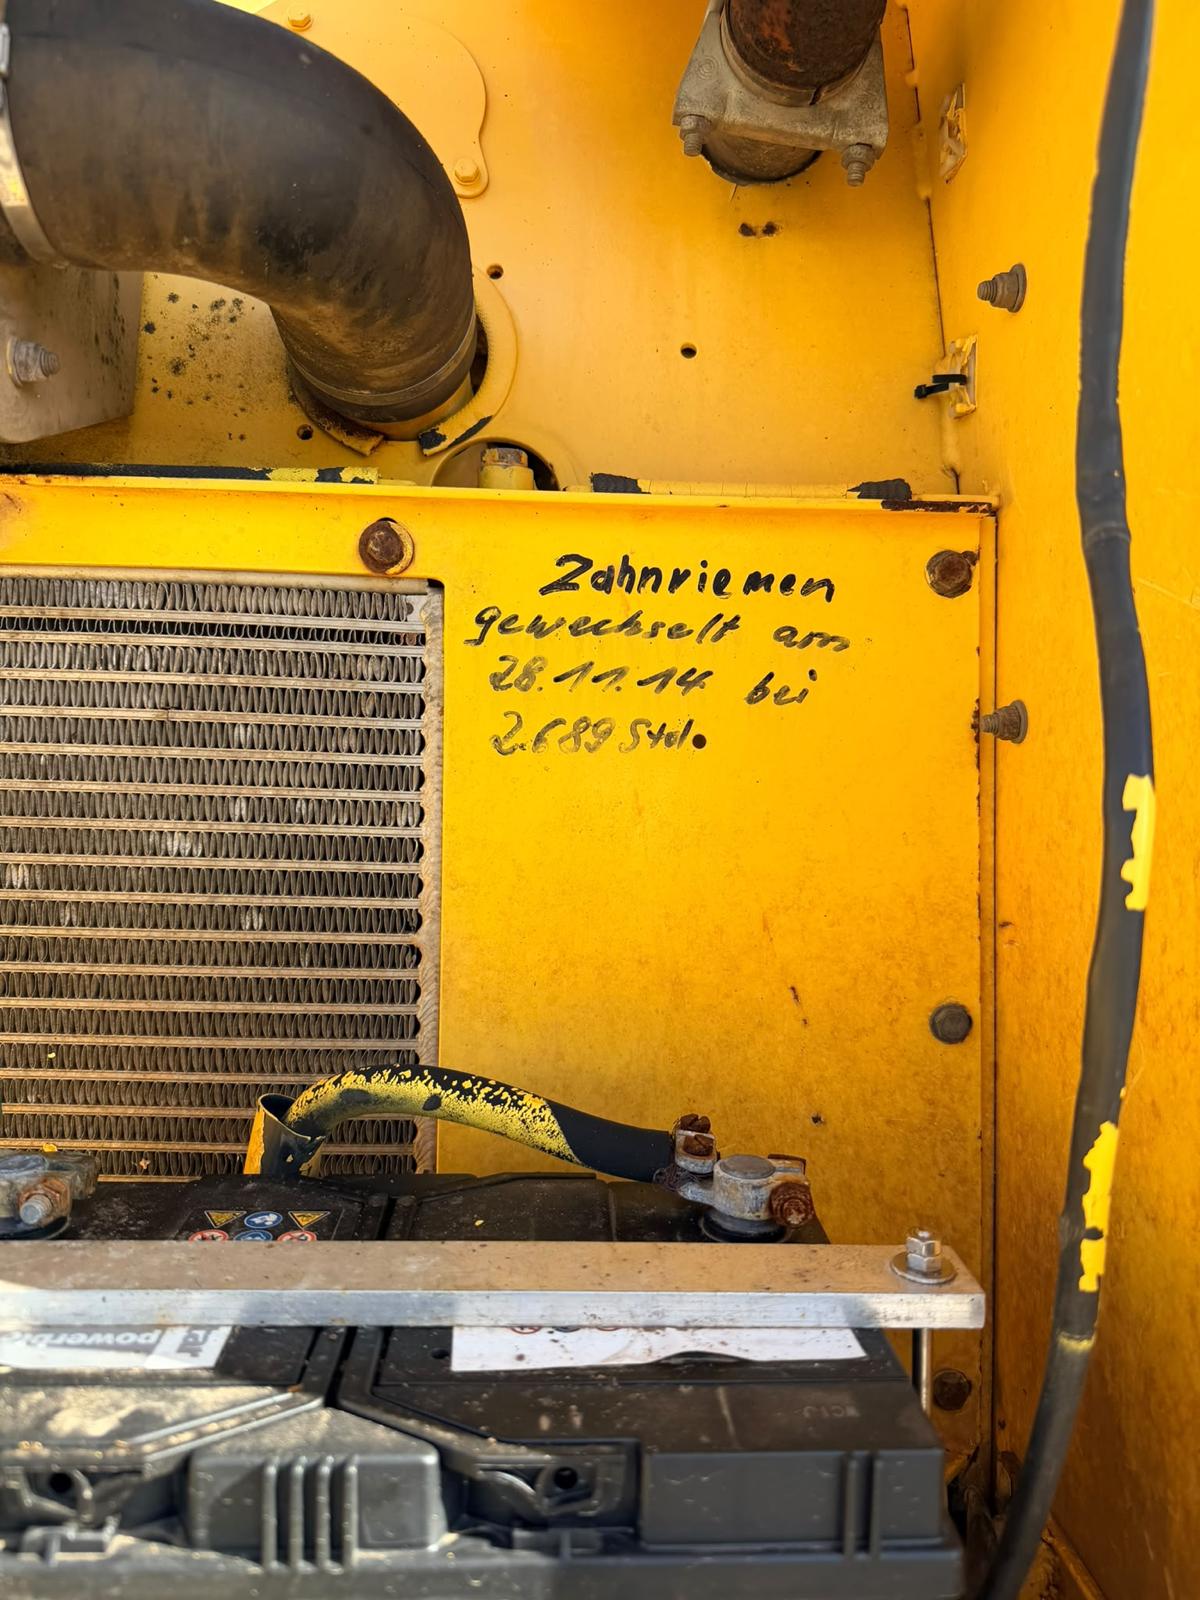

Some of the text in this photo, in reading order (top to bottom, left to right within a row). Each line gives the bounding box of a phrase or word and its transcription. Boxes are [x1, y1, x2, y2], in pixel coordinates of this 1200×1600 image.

[538, 553, 836, 603] Zahnriemen
[463, 605, 851, 653] gewechselt am
[744, 668, 818, 706] bei
